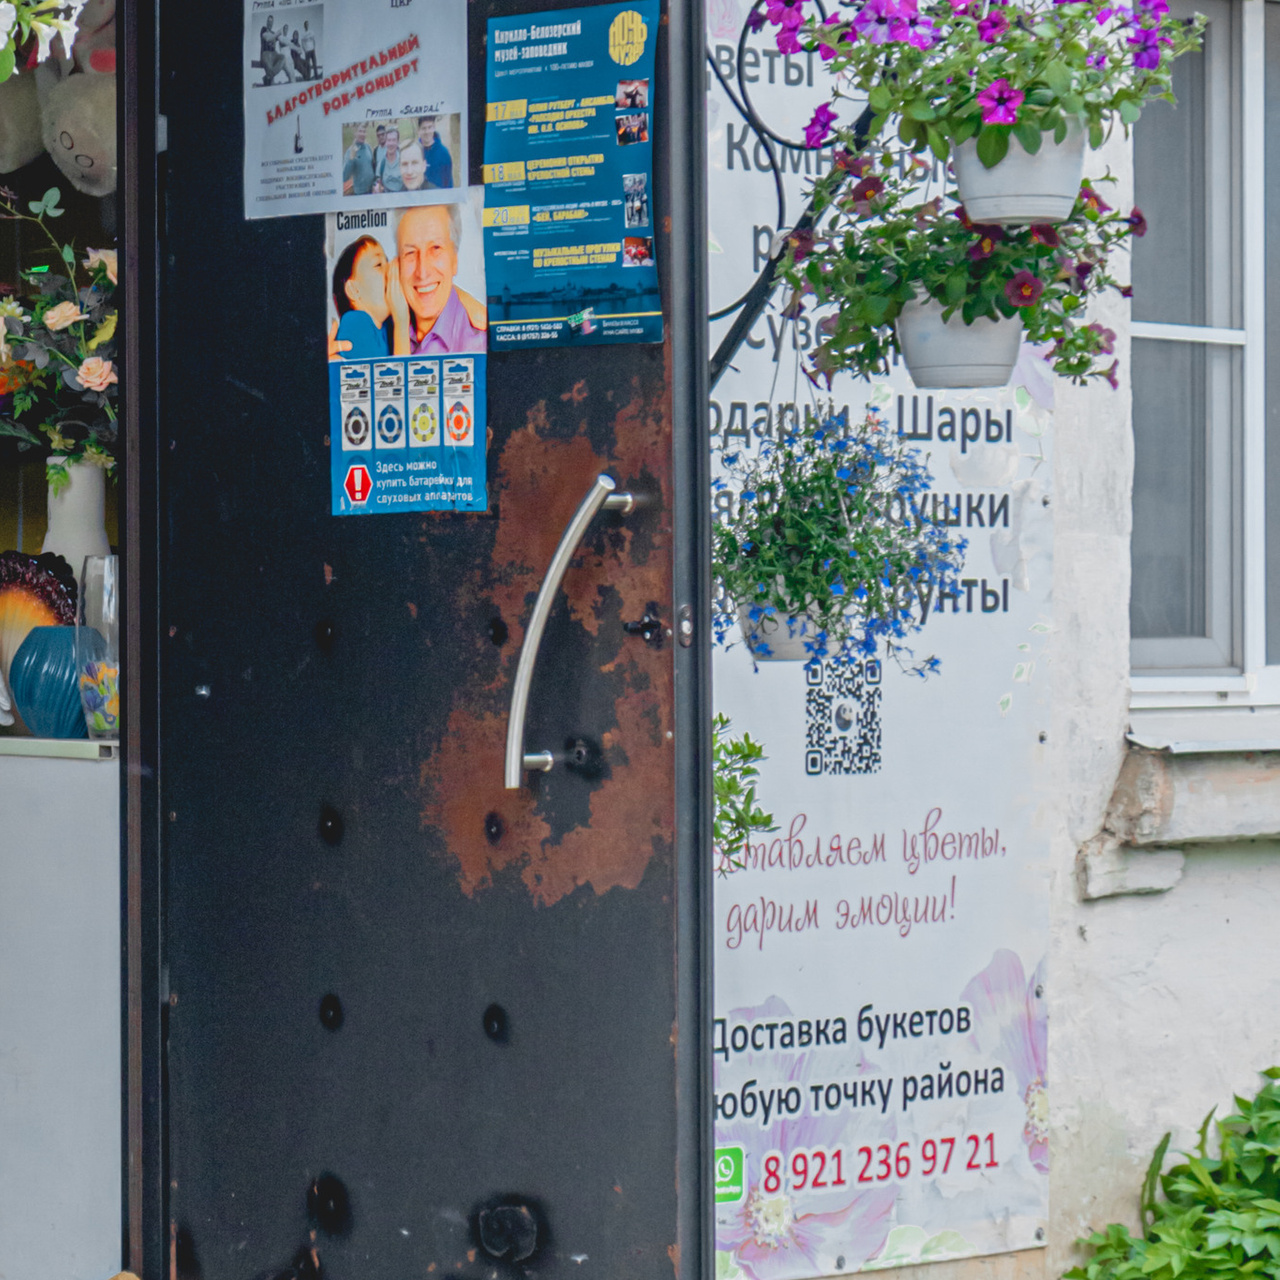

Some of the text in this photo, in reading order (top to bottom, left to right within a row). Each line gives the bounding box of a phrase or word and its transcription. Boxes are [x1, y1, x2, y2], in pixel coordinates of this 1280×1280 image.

[494, 20, 582, 44] Кирилло-Белозерский
[494, 42, 568, 63] музей-заповедник
[265, 33, 421, 126] БЛАГОТВОРИТЕЛЬНЫЙ
[322, 58, 419, 117] РОК-КОНЦЕРТ
[494, 103, 507, 120] 17
[491, 165, 504, 181] 18
[337, 209, 387, 231] Camelion
[493, 209, 508, 225] 20
[897, 394, 1013, 454] Шары
[376, 461, 437, 473] Здесь можно
[376, 473, 473, 490] купить батарейку для
[376, 493, 422, 505] слуховых
[902, 806, 1007, 876] цветы,
[726, 875, 957, 951] дарим эмоции!
[713, 1003, 971, 1062] Доставка букетов
[810, 1077, 894, 1114] точку
[902, 1061, 1005, 1112] района
[763, 1131, 1000, 1194] 8 921 236 97 21
